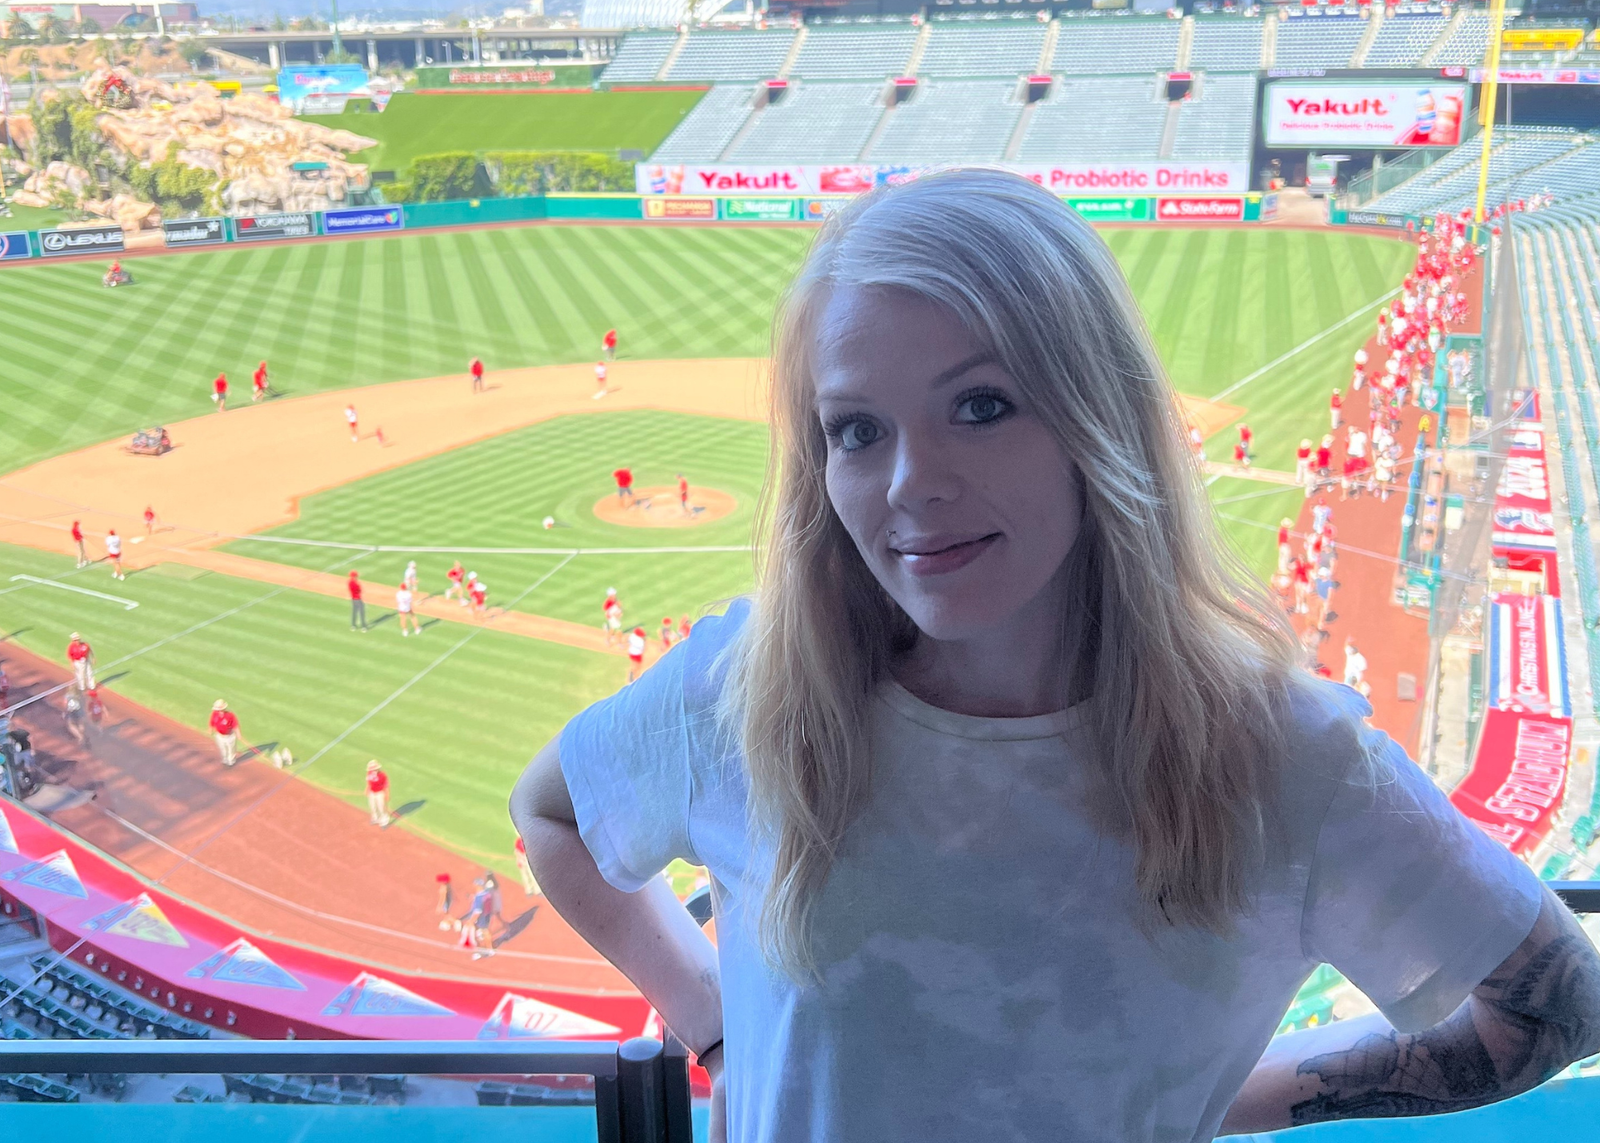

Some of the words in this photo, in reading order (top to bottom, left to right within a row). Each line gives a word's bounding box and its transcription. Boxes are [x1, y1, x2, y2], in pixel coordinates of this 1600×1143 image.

[1286, 98, 1390, 116] Yakult
[699, 171, 799, 190] Yakult
[1050, 169, 1148, 188] Probiotic
[1155, 168, 1230, 187] Drinks
[66, 230, 124, 247] LEXUS
